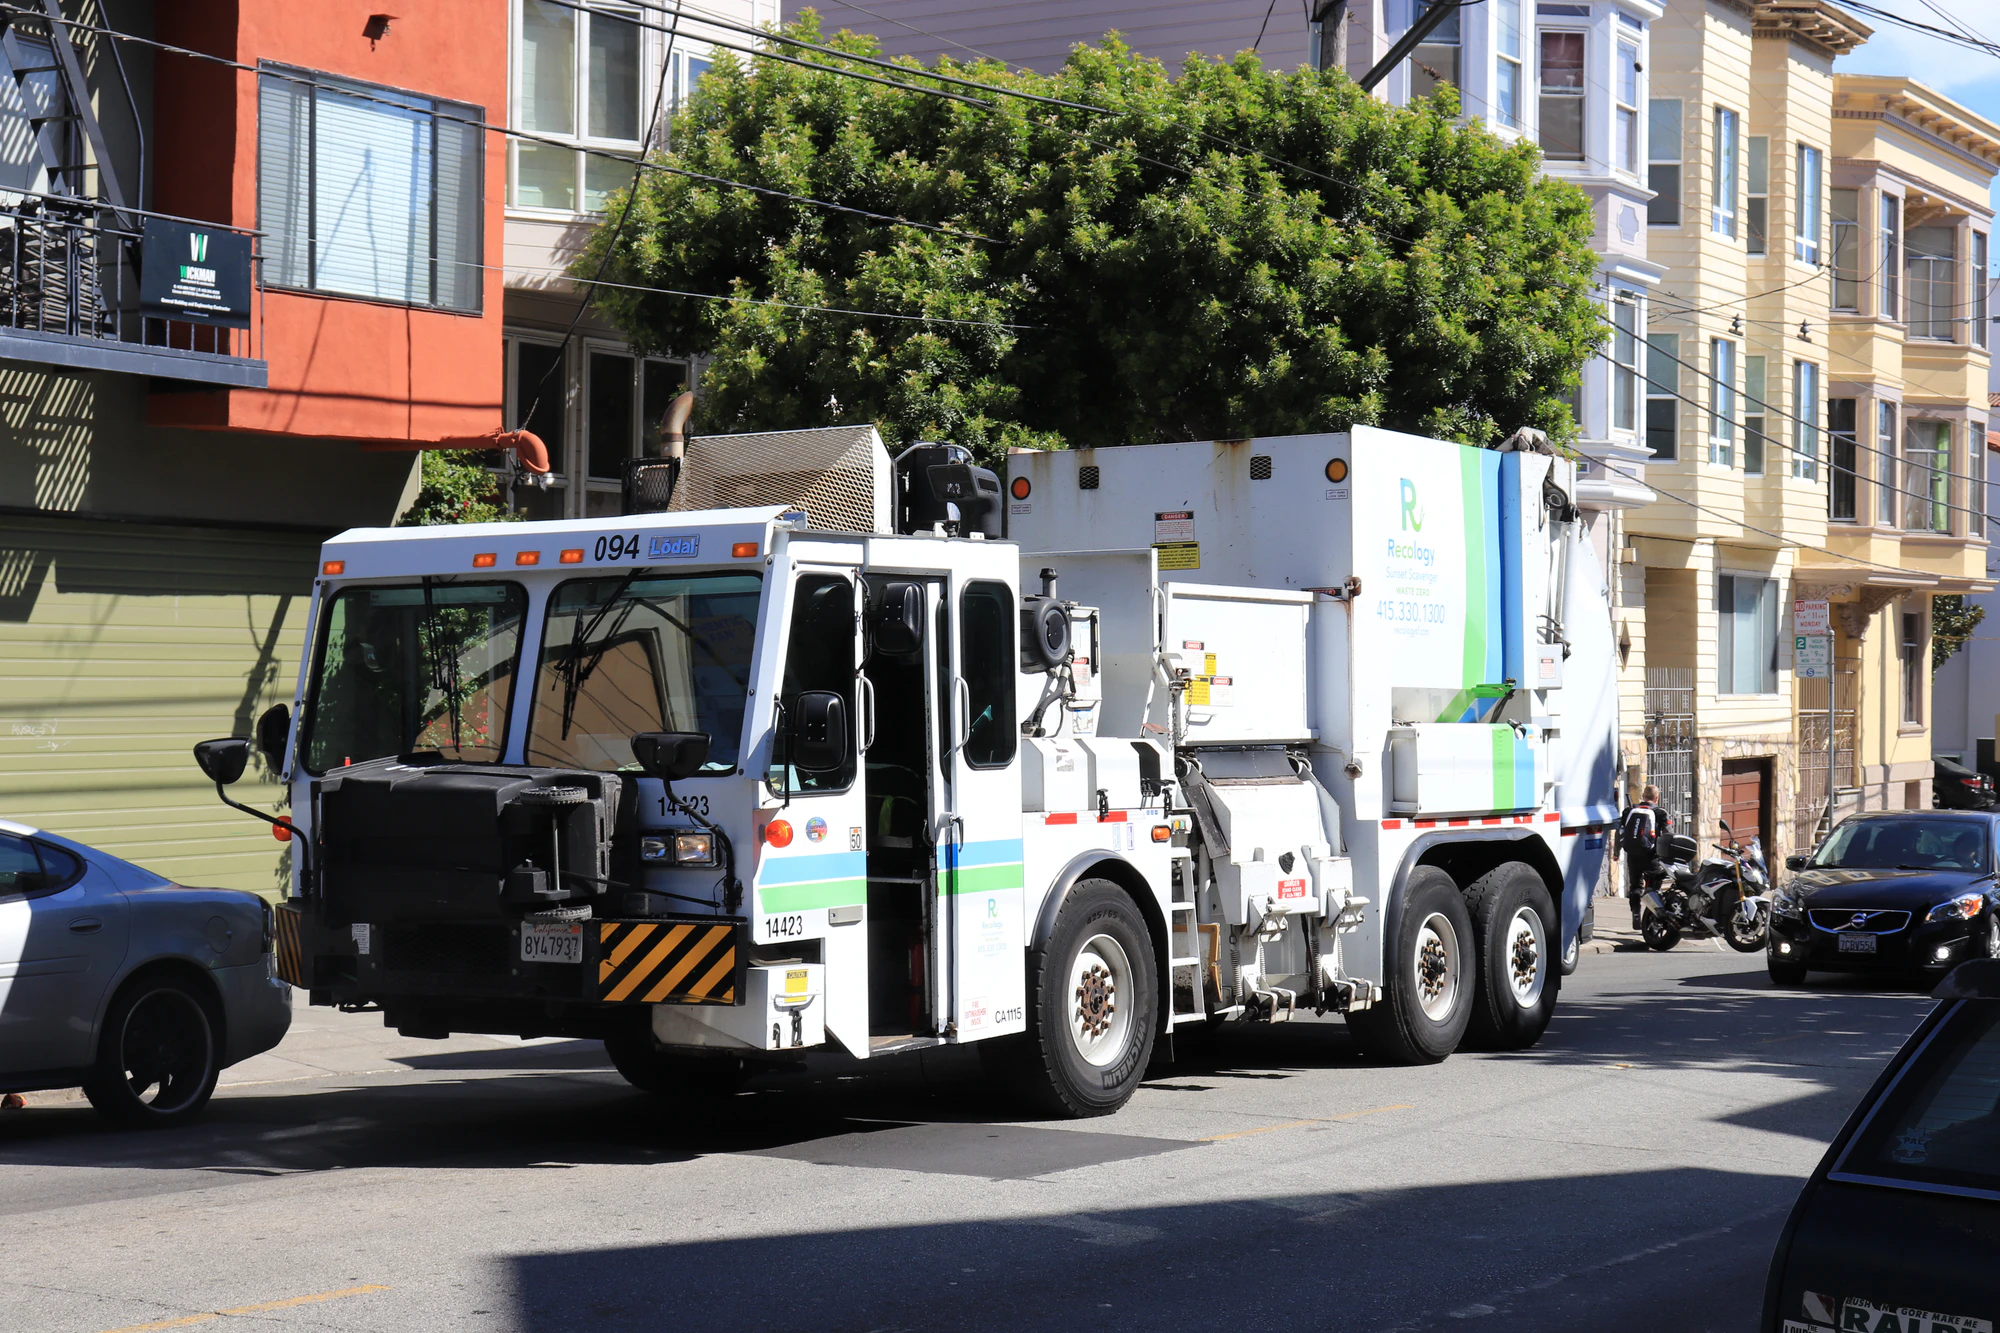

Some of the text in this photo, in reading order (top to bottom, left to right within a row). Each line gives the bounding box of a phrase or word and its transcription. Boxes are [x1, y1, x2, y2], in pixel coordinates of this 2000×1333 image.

[180, 265, 216, 283] WICKMAN
[594, 534, 640, 561] 094
[1387, 538, 1435, 566] Recology
[1386, 566, 1438, 584] Sunset Scavenger
[1395, 586, 1430, 597] WASTE ZERO
[1376, 600, 1445, 624] 415.330.1300
[1795, 603, 1826, 611] NO PARKING
[1798, 638, 1805, 648] 2
[851, 833, 861, 849] 50
[533, 924, 570, 936] California
[766, 915, 803, 938] 14423
[1103, 1020, 1146, 1088] MICHELIN
[1904, 1137, 1922, 1145] PAL
[1846, 1297, 1871, 1308] BUSH
[1901, 1308, 1929, 1320] GORE
[1932, 1313, 1961, 1325] MAKE
[1964, 1319, 1978, 1329] ME
